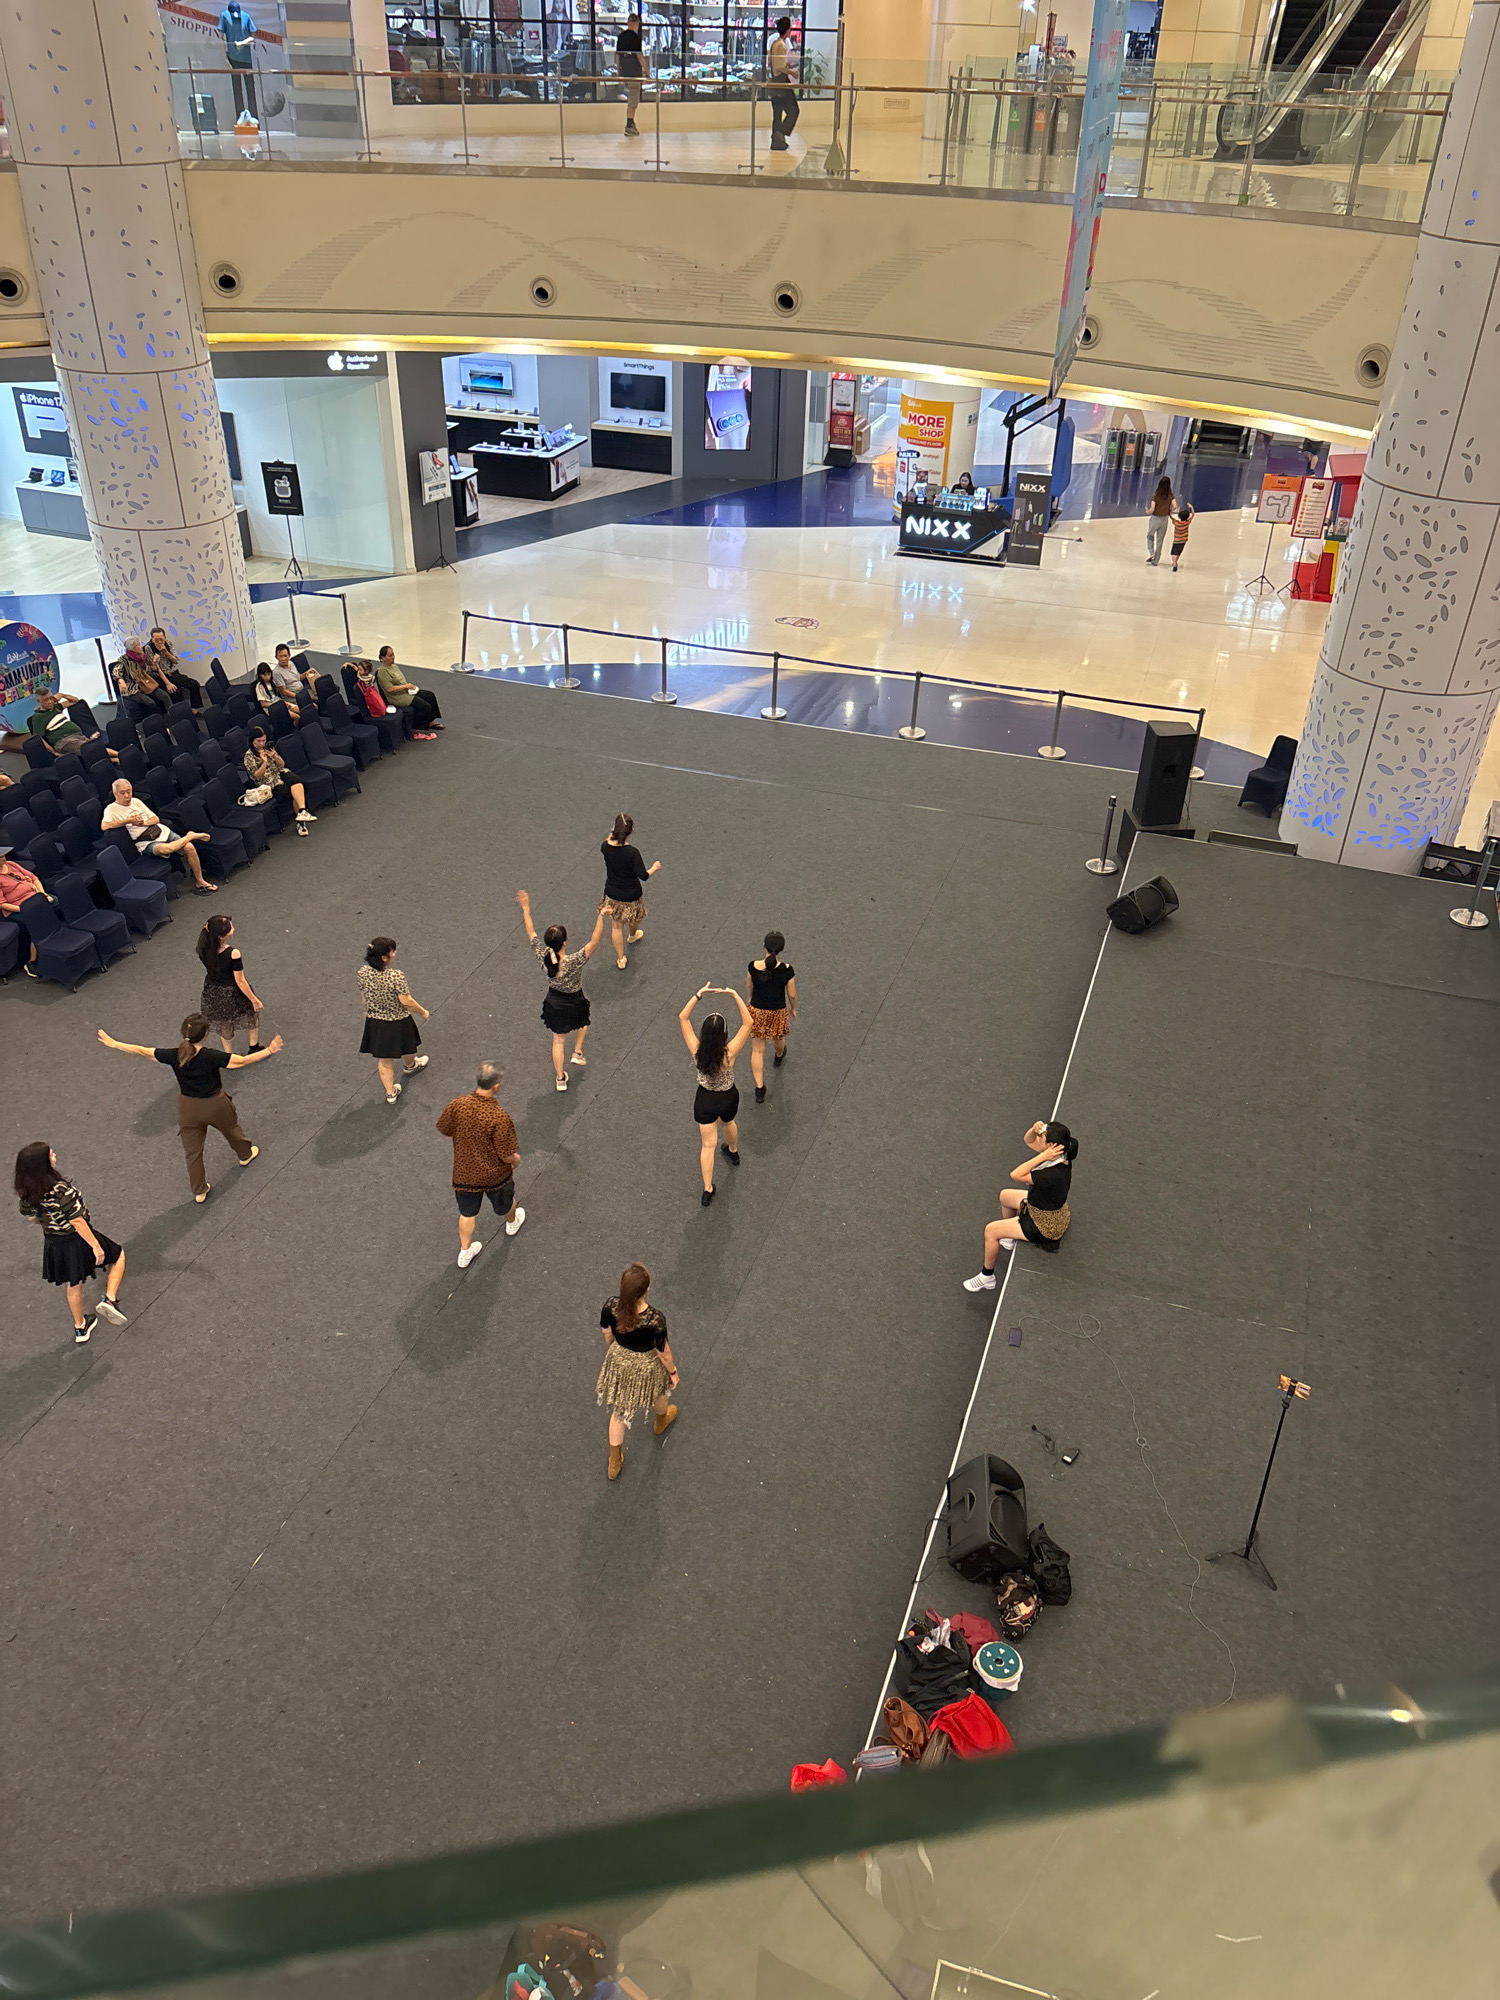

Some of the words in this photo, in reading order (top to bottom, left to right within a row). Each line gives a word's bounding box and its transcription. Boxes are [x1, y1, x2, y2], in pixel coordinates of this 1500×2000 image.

[623, 361, 655, 371] SmartThings
[26, 393, 54, 406] iPhone
[908, 412, 945, 428] MORE
[919, 428, 944, 438] SHOP
[1020, 483, 1046, 494] NIXX
[906, 515, 972, 540] NIXX
